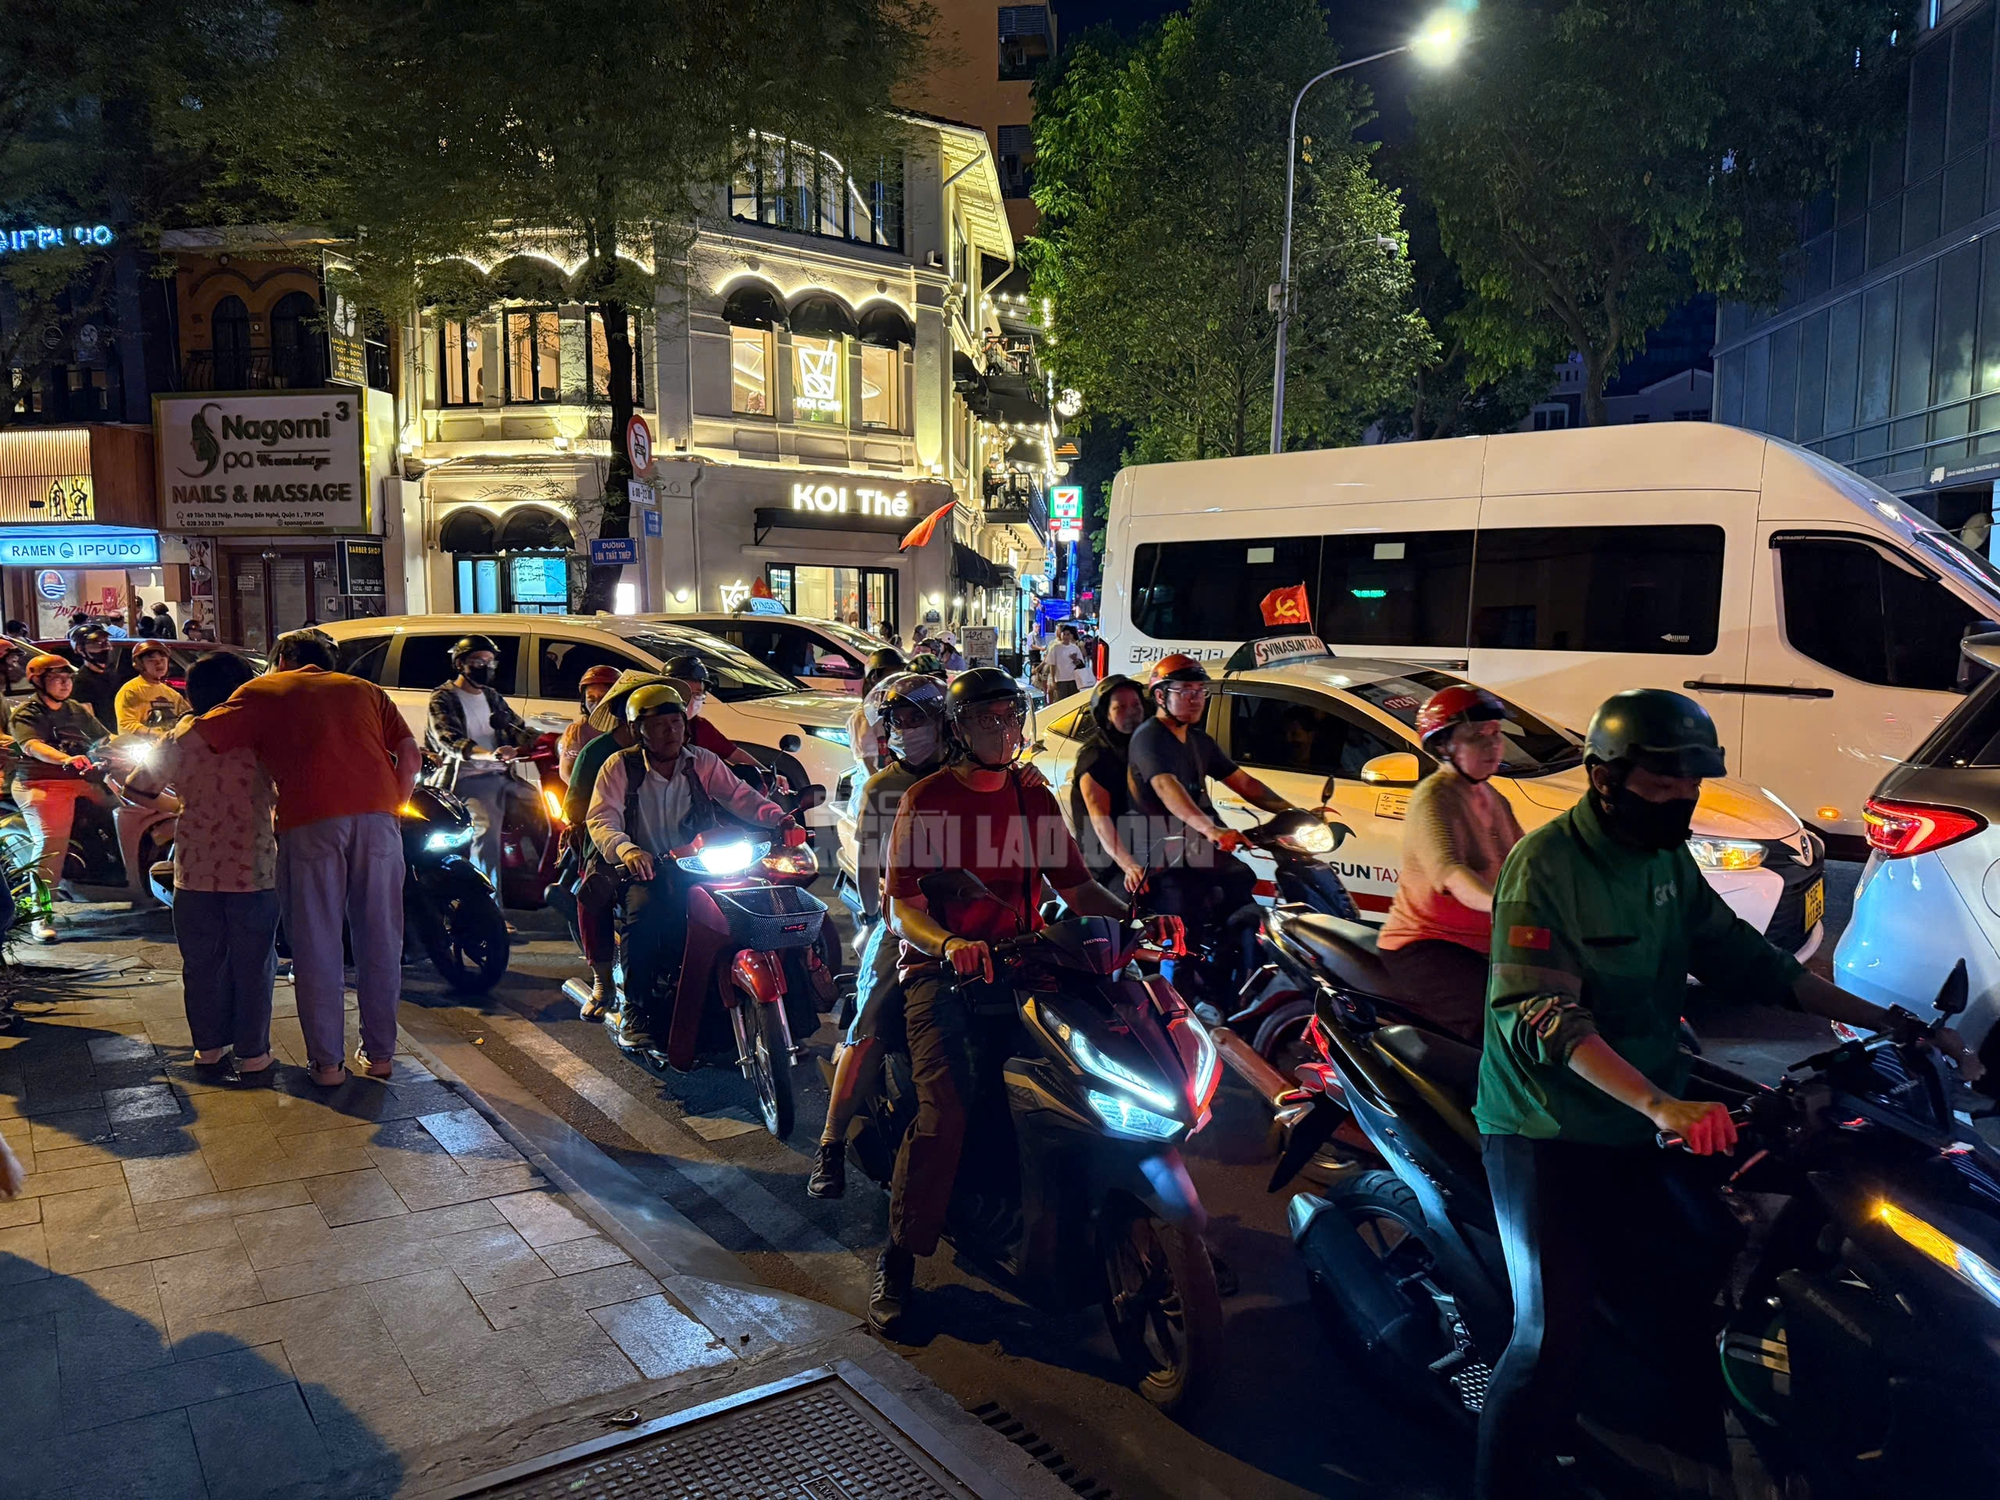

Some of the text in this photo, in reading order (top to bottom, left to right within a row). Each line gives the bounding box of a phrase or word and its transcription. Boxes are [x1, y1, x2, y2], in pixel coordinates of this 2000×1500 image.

[221, 401, 350, 446] Nagomi 3
[172, 483, 351, 503] NAILS & MASSAGE
[792, 483, 909, 517] KOI Thé
[12, 544, 141, 557] RAMEN IPPUDO
[349, 546, 380, 555] BARBER SHOP
[1265, 638, 1323, 656] VINASUNTAXI
[1384, 696, 1420, 709] 17247
[1083, 937, 1109, 945] HONDA
